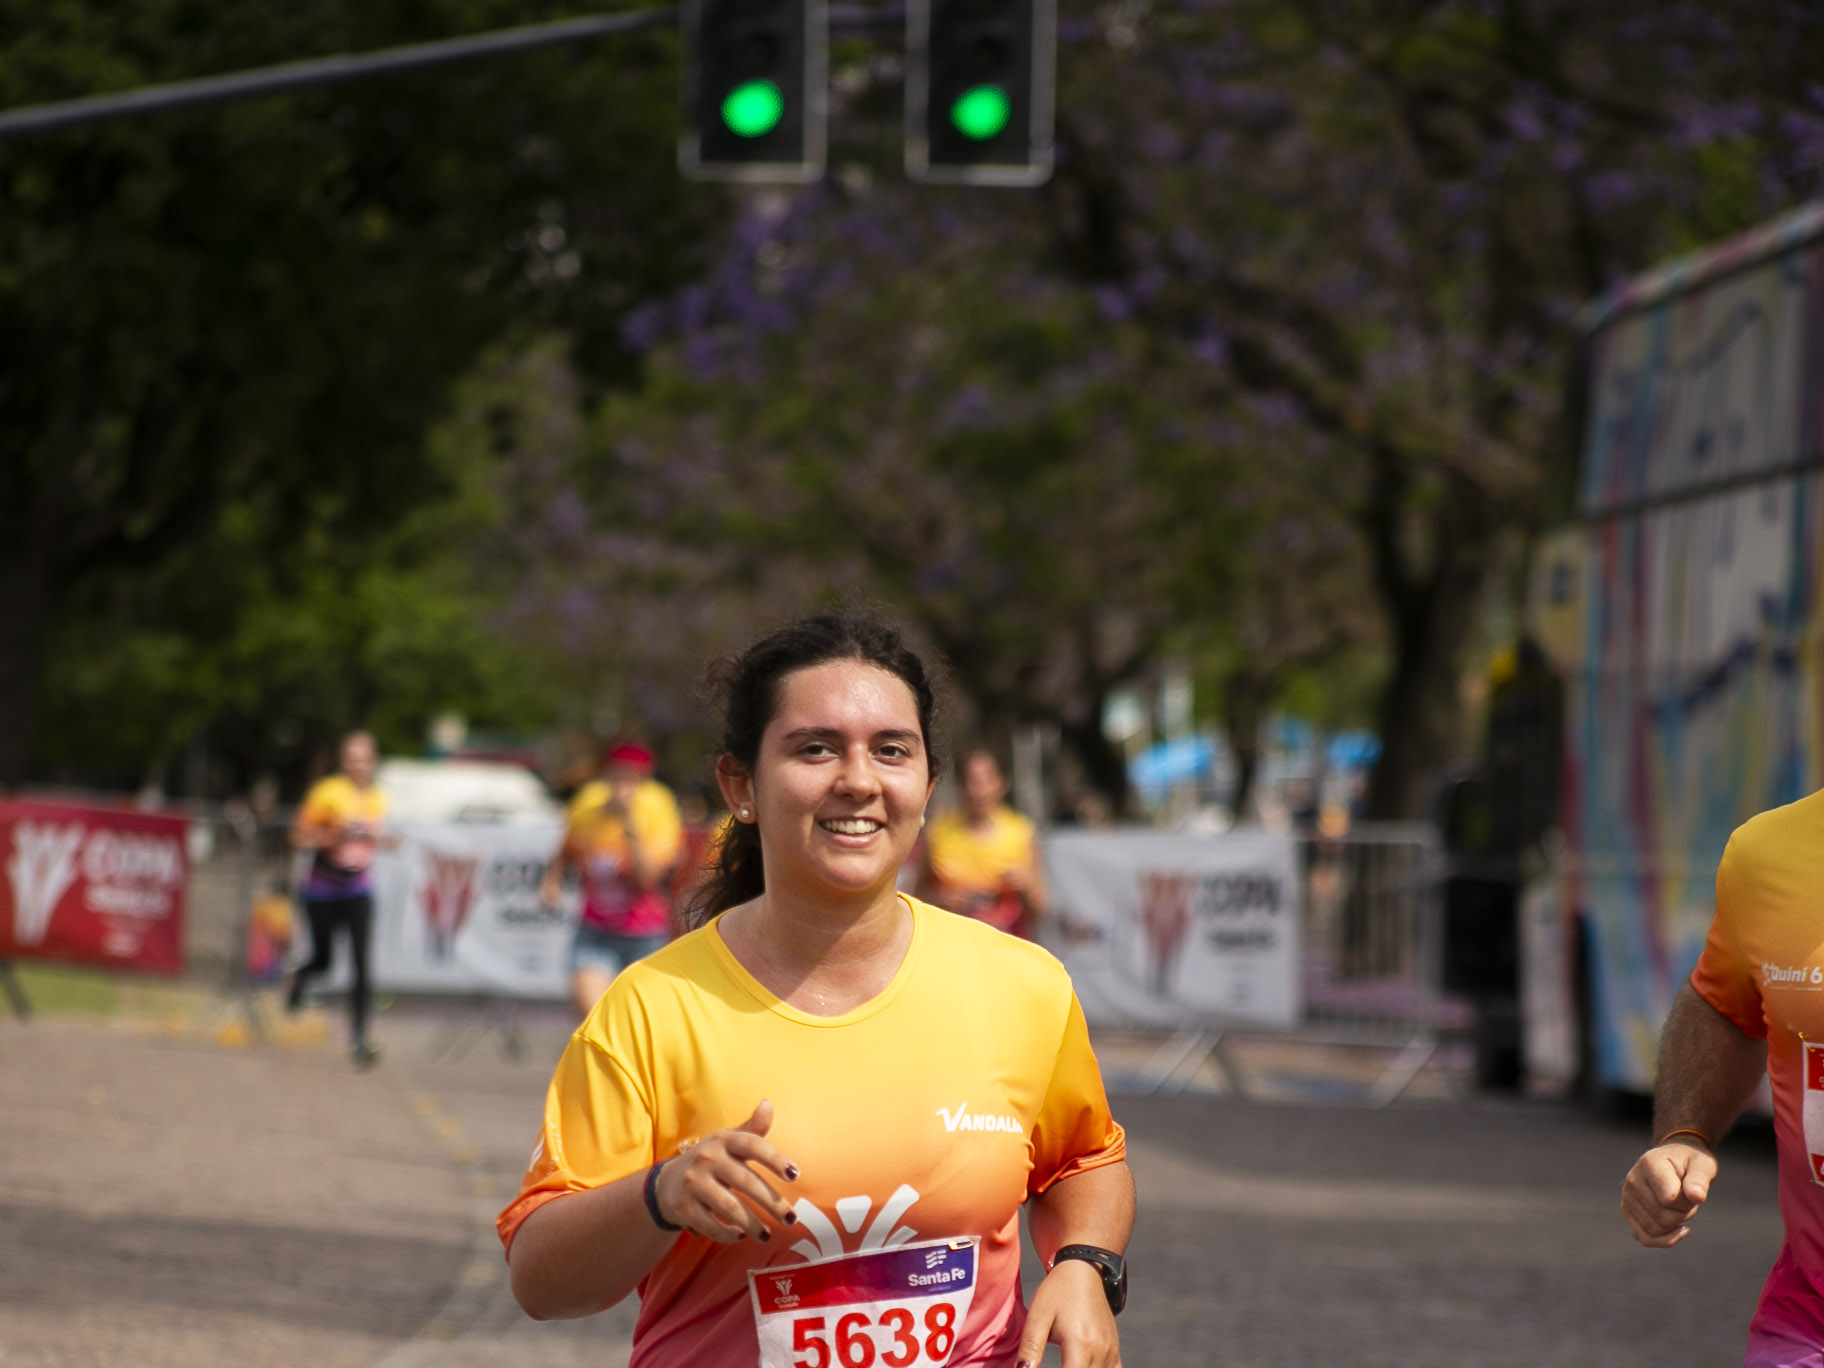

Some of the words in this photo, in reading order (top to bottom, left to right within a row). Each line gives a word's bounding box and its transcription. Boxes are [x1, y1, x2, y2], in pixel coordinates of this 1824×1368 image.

[1810, 966, 1823, 985] 6
[908, 1271, 951, 1287] Santa
[951, 1267, 966, 1281] Fe
